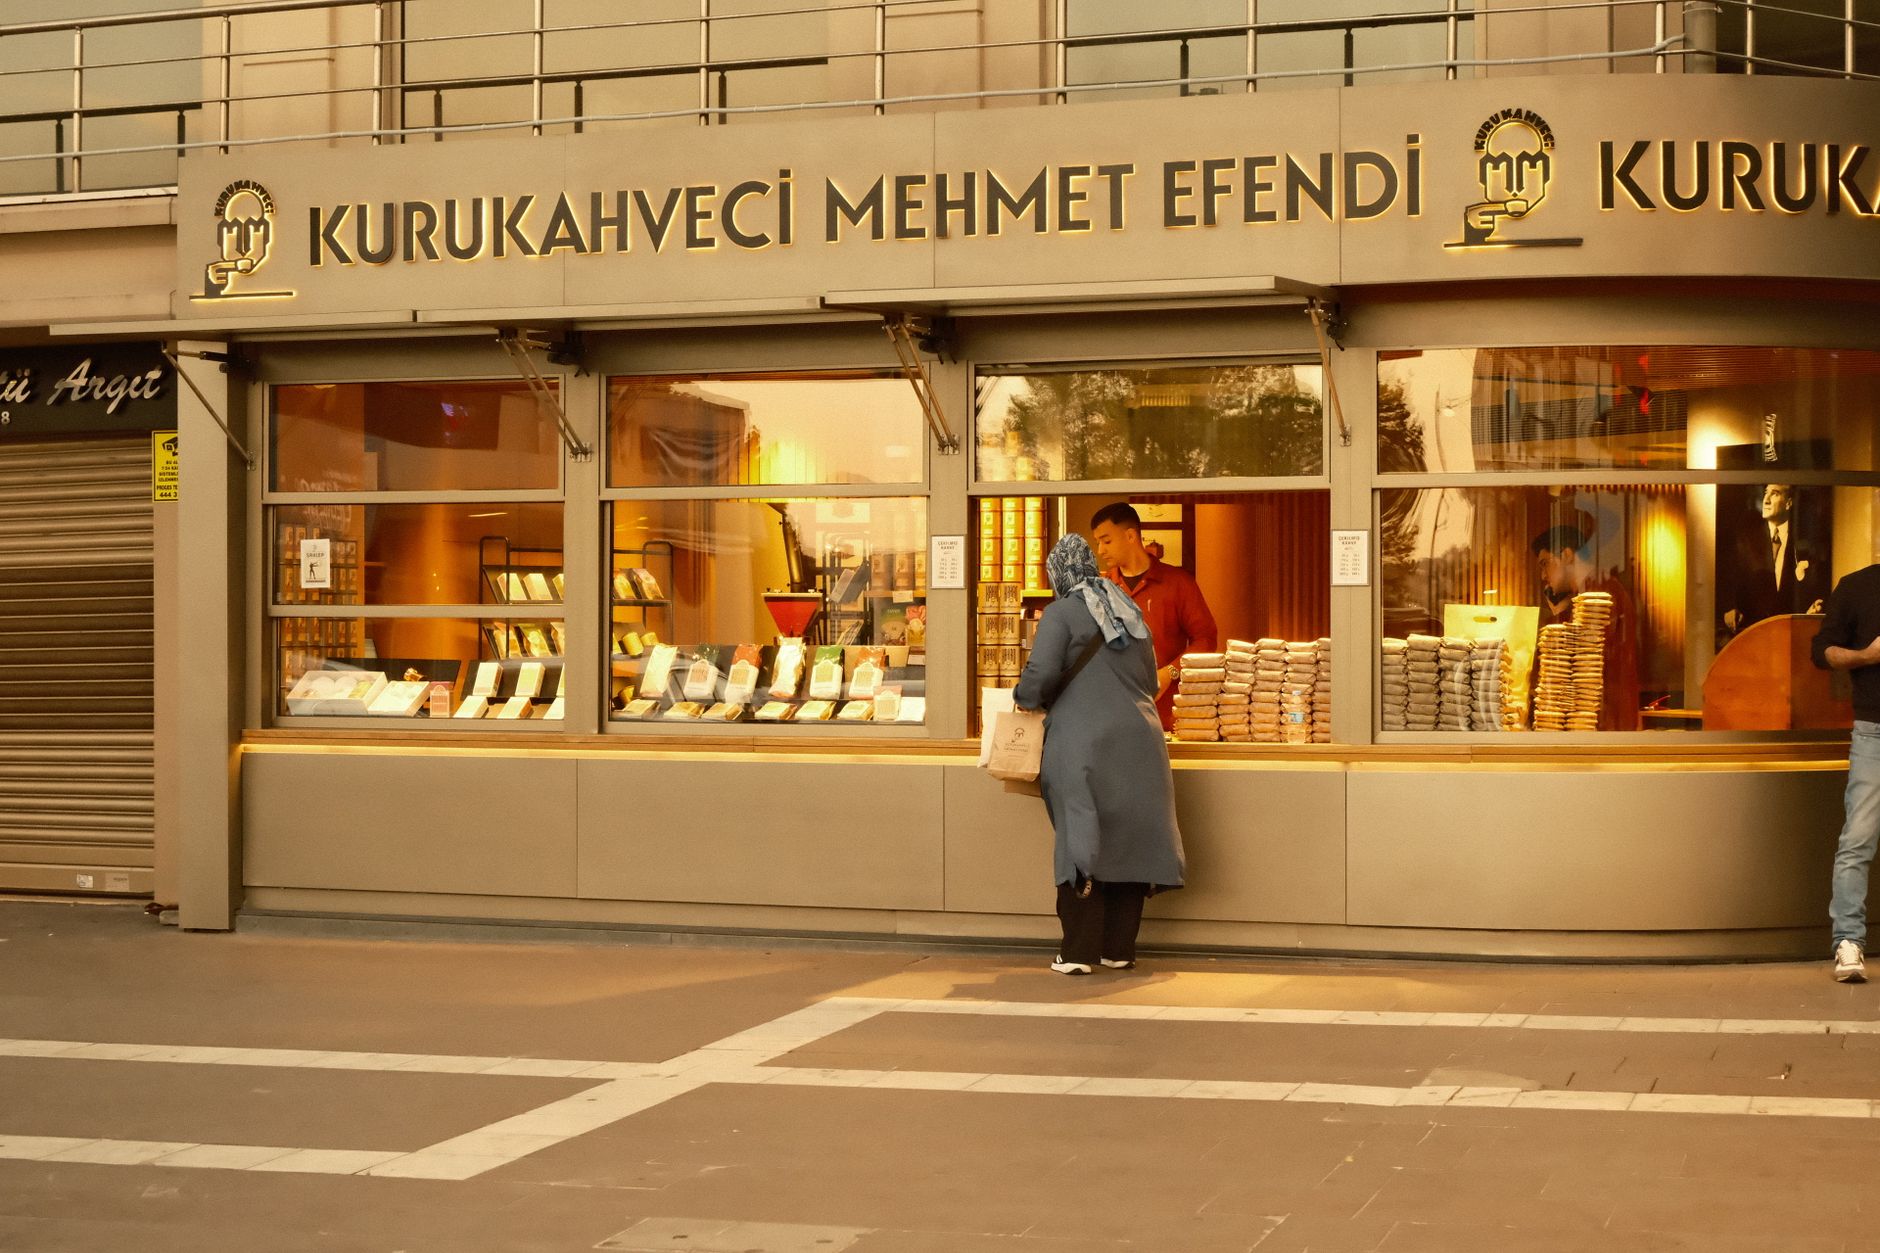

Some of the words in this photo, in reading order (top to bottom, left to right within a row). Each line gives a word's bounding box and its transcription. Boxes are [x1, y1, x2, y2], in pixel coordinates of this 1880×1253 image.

[310, 169, 791, 267] KURUKAHVECİ
[826, 165, 1134, 243] MEHMET
[1163, 133, 1421, 229] EFENDİ
[1600, 140, 1880, 216] KURUK
